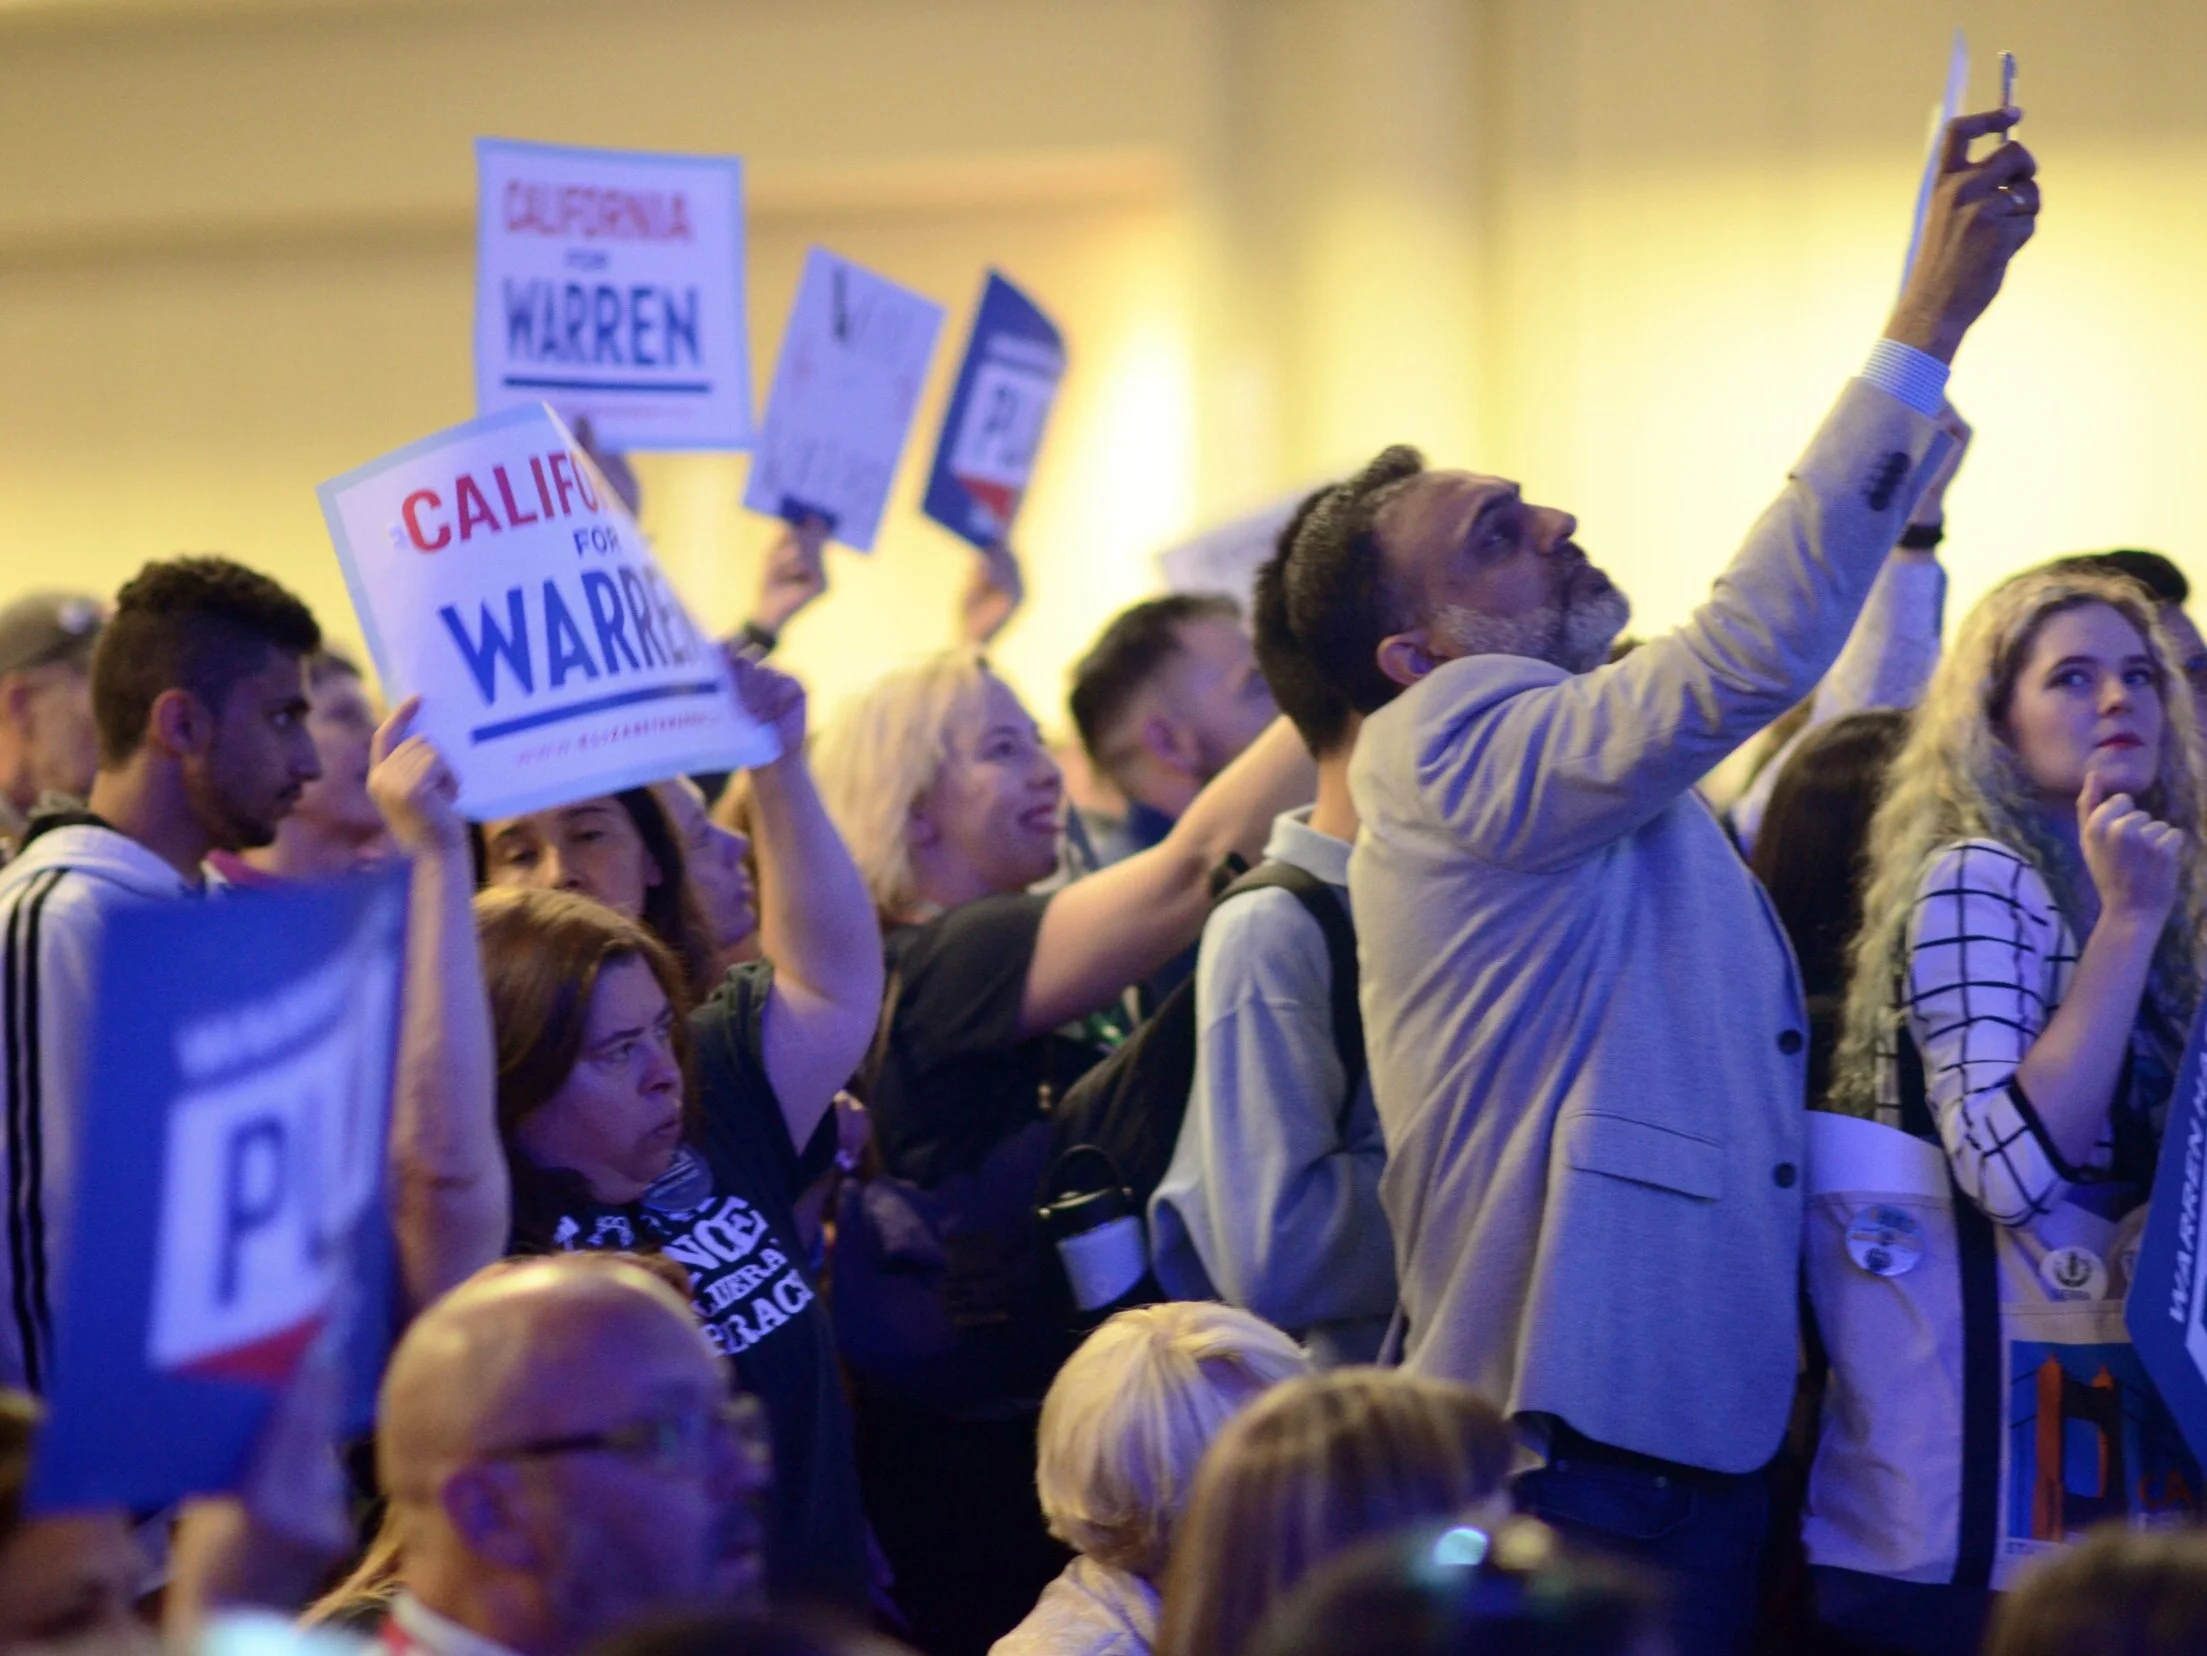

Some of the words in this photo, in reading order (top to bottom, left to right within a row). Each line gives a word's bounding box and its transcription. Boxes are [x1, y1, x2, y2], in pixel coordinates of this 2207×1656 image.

[503, 275, 702, 368] WARREN
[572, 526, 620, 559] FOR
[2169, 1117, 2203, 1323] WARREN
